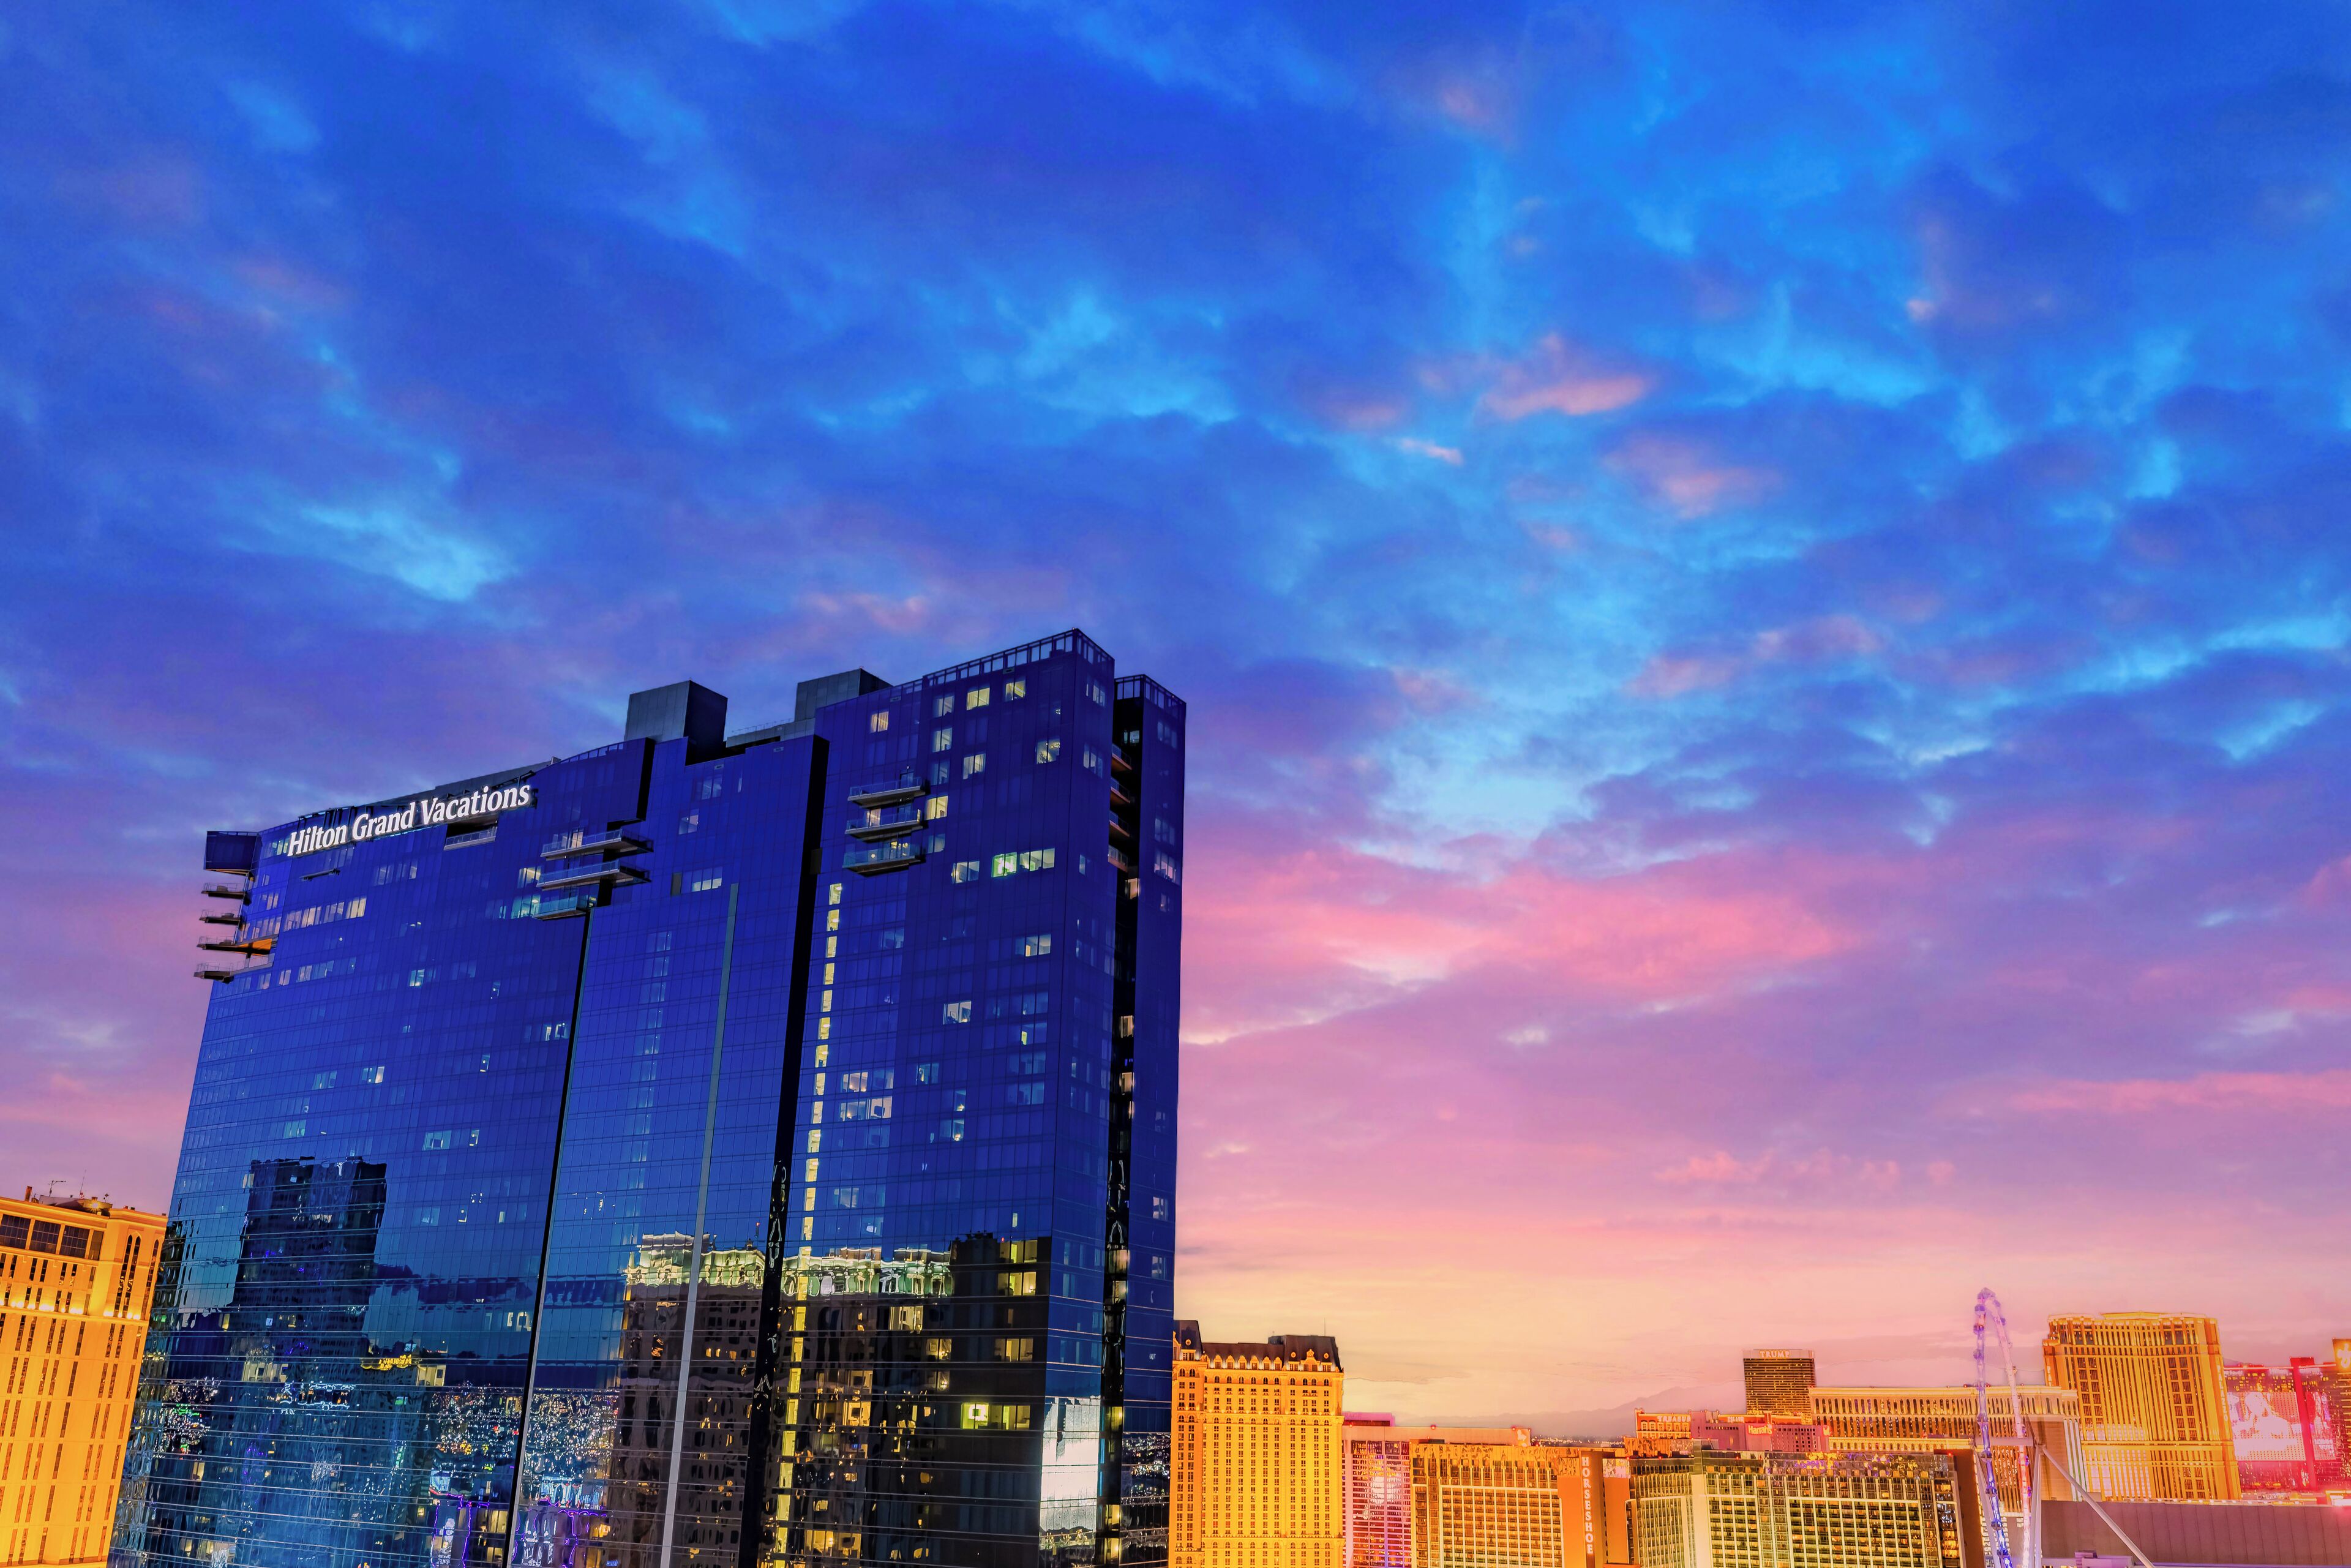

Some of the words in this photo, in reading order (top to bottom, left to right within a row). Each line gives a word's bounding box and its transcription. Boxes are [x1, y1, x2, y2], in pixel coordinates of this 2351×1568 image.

[288, 825, 347, 857] Hilton
[352, 802, 416, 841] Grand
[421, 786, 530, 825] Vacations
[1582, 1457, 1594, 1554] HORSESHOE
